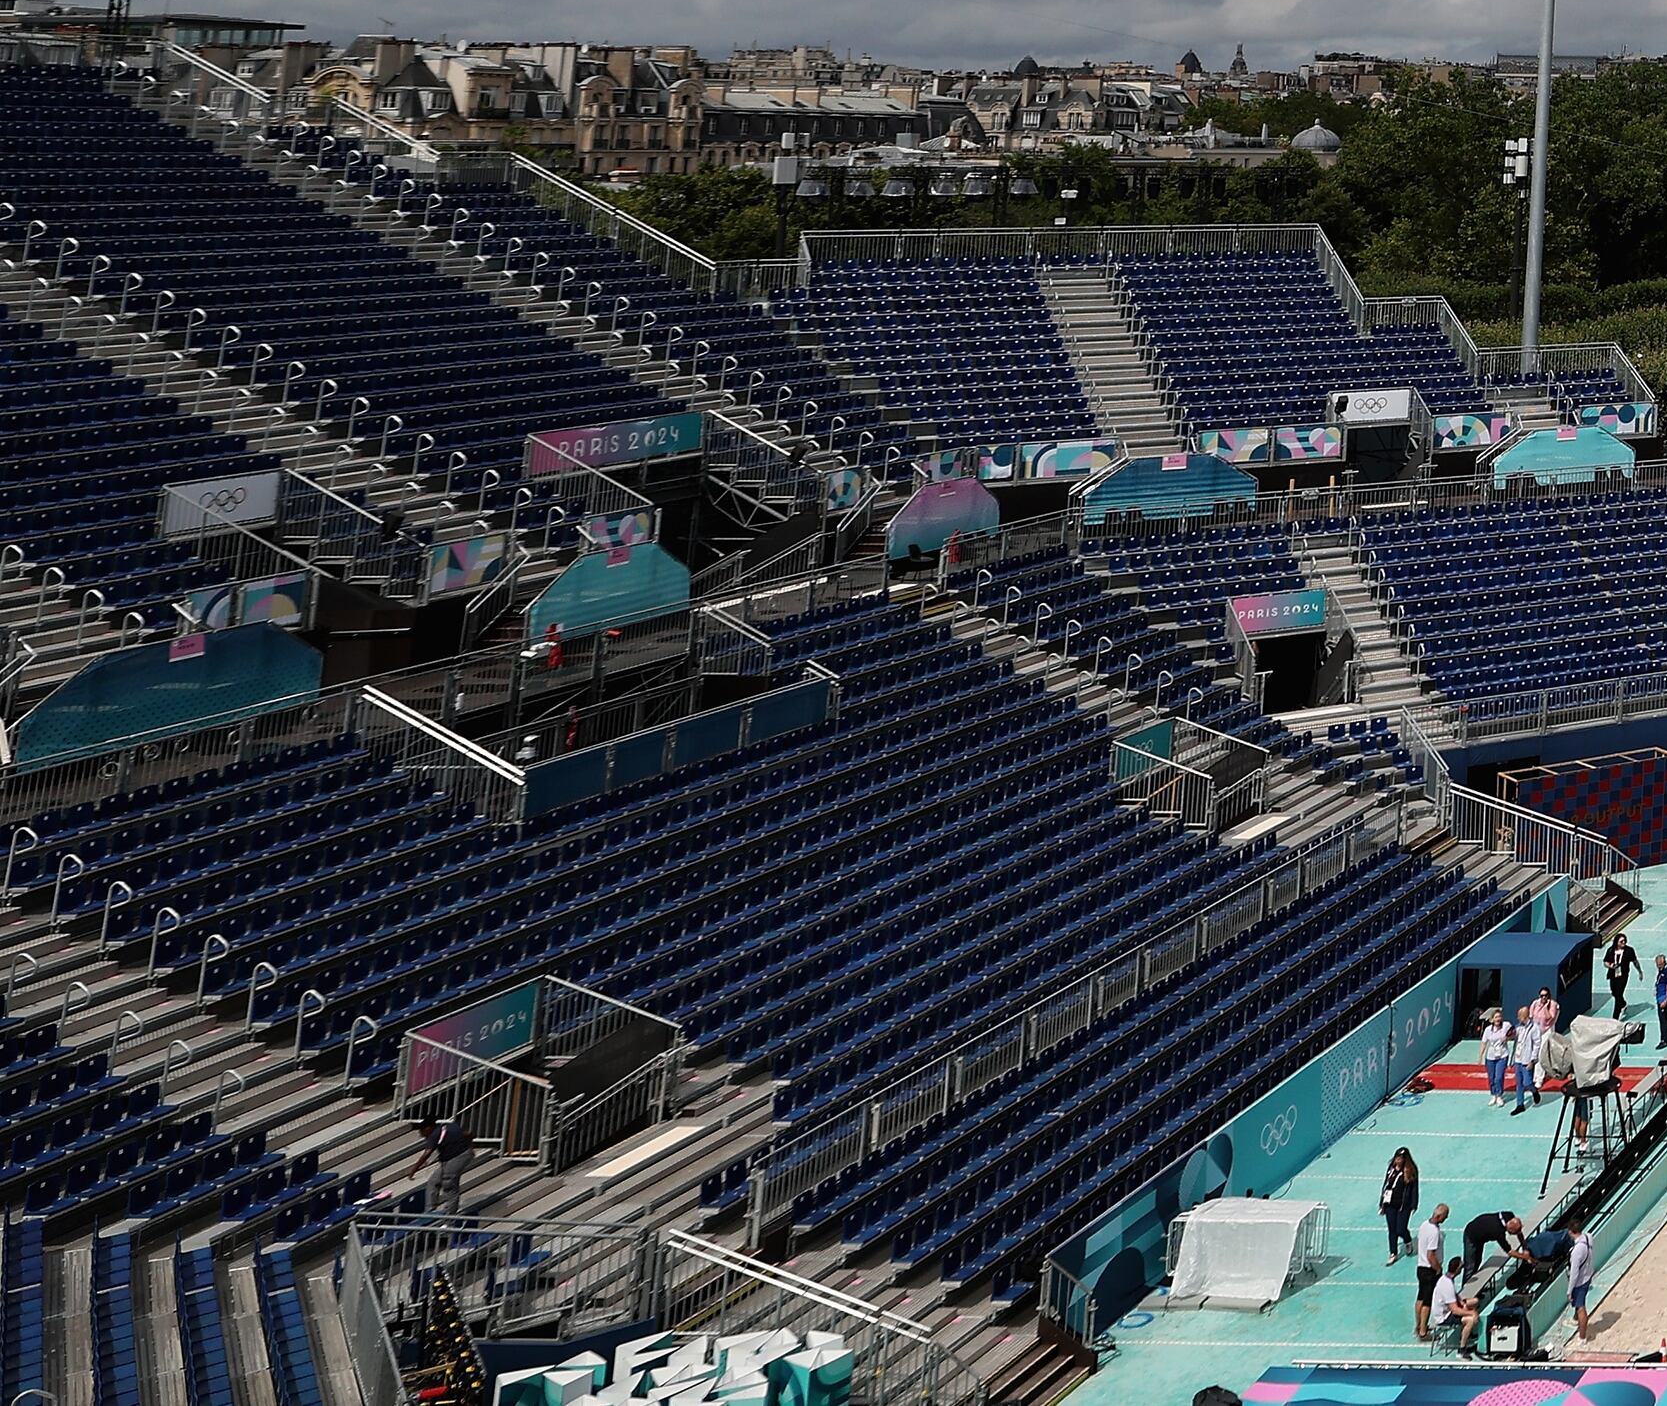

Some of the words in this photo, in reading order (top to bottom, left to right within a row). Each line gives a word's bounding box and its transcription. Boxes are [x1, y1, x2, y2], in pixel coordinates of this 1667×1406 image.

[628, 425, 679, 451] 2024
[1282, 603, 1319, 616] 2024
[480, 1010, 527, 1041] 2024
[1405, 991, 1453, 1049] 2024
